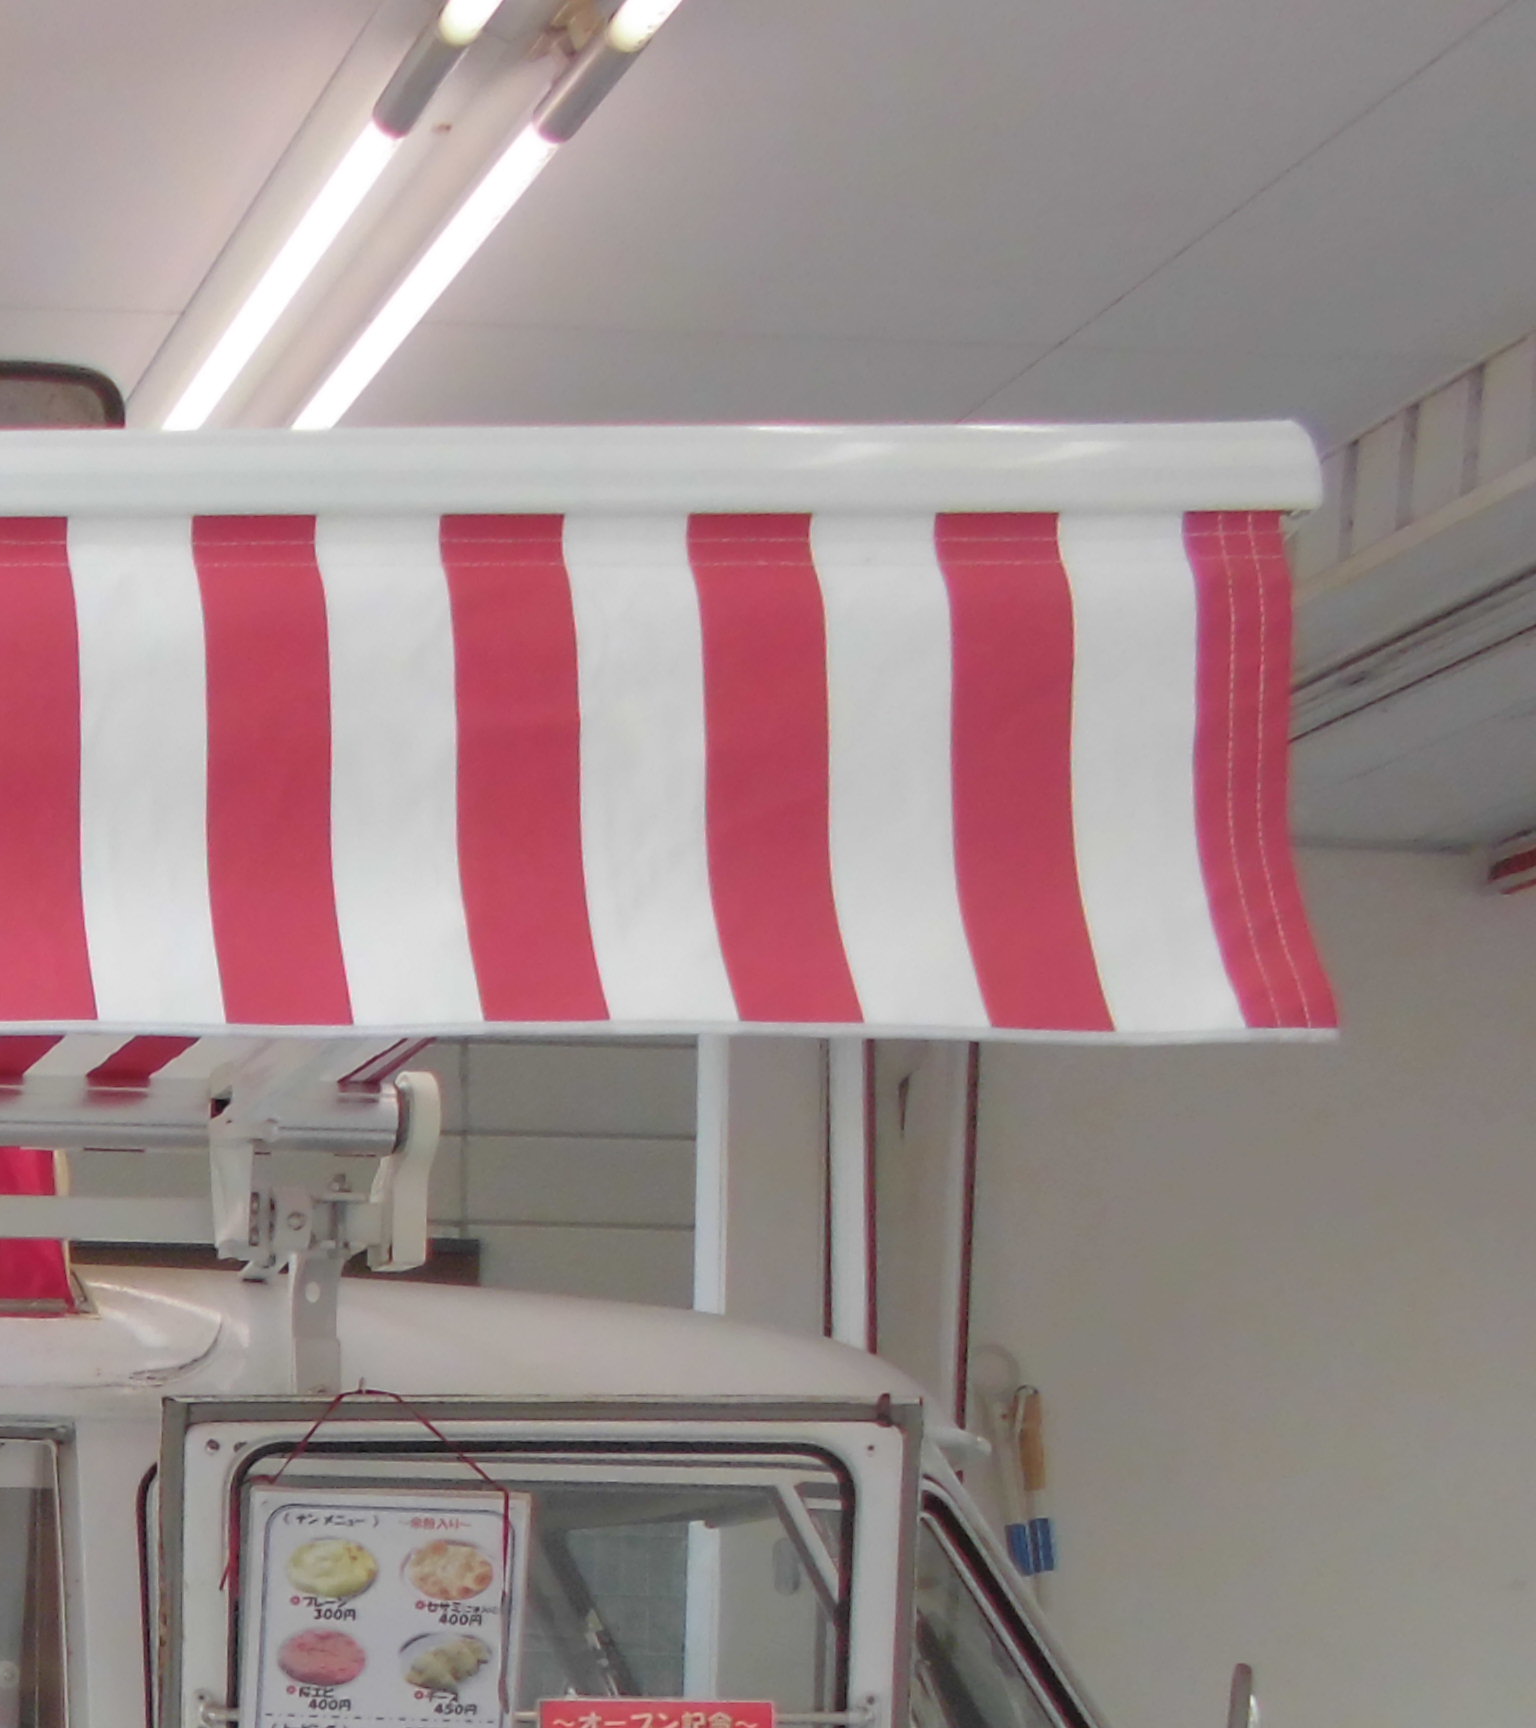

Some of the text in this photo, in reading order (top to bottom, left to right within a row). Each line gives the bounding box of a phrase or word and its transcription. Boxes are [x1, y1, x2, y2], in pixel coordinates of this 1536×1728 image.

[314, 1608, 357, 1621] 300円
[439, 1614, 482, 1626] 400円
[308, 1699, 352, 1712] 400円
[434, 1703, 478, 1716] 450円
